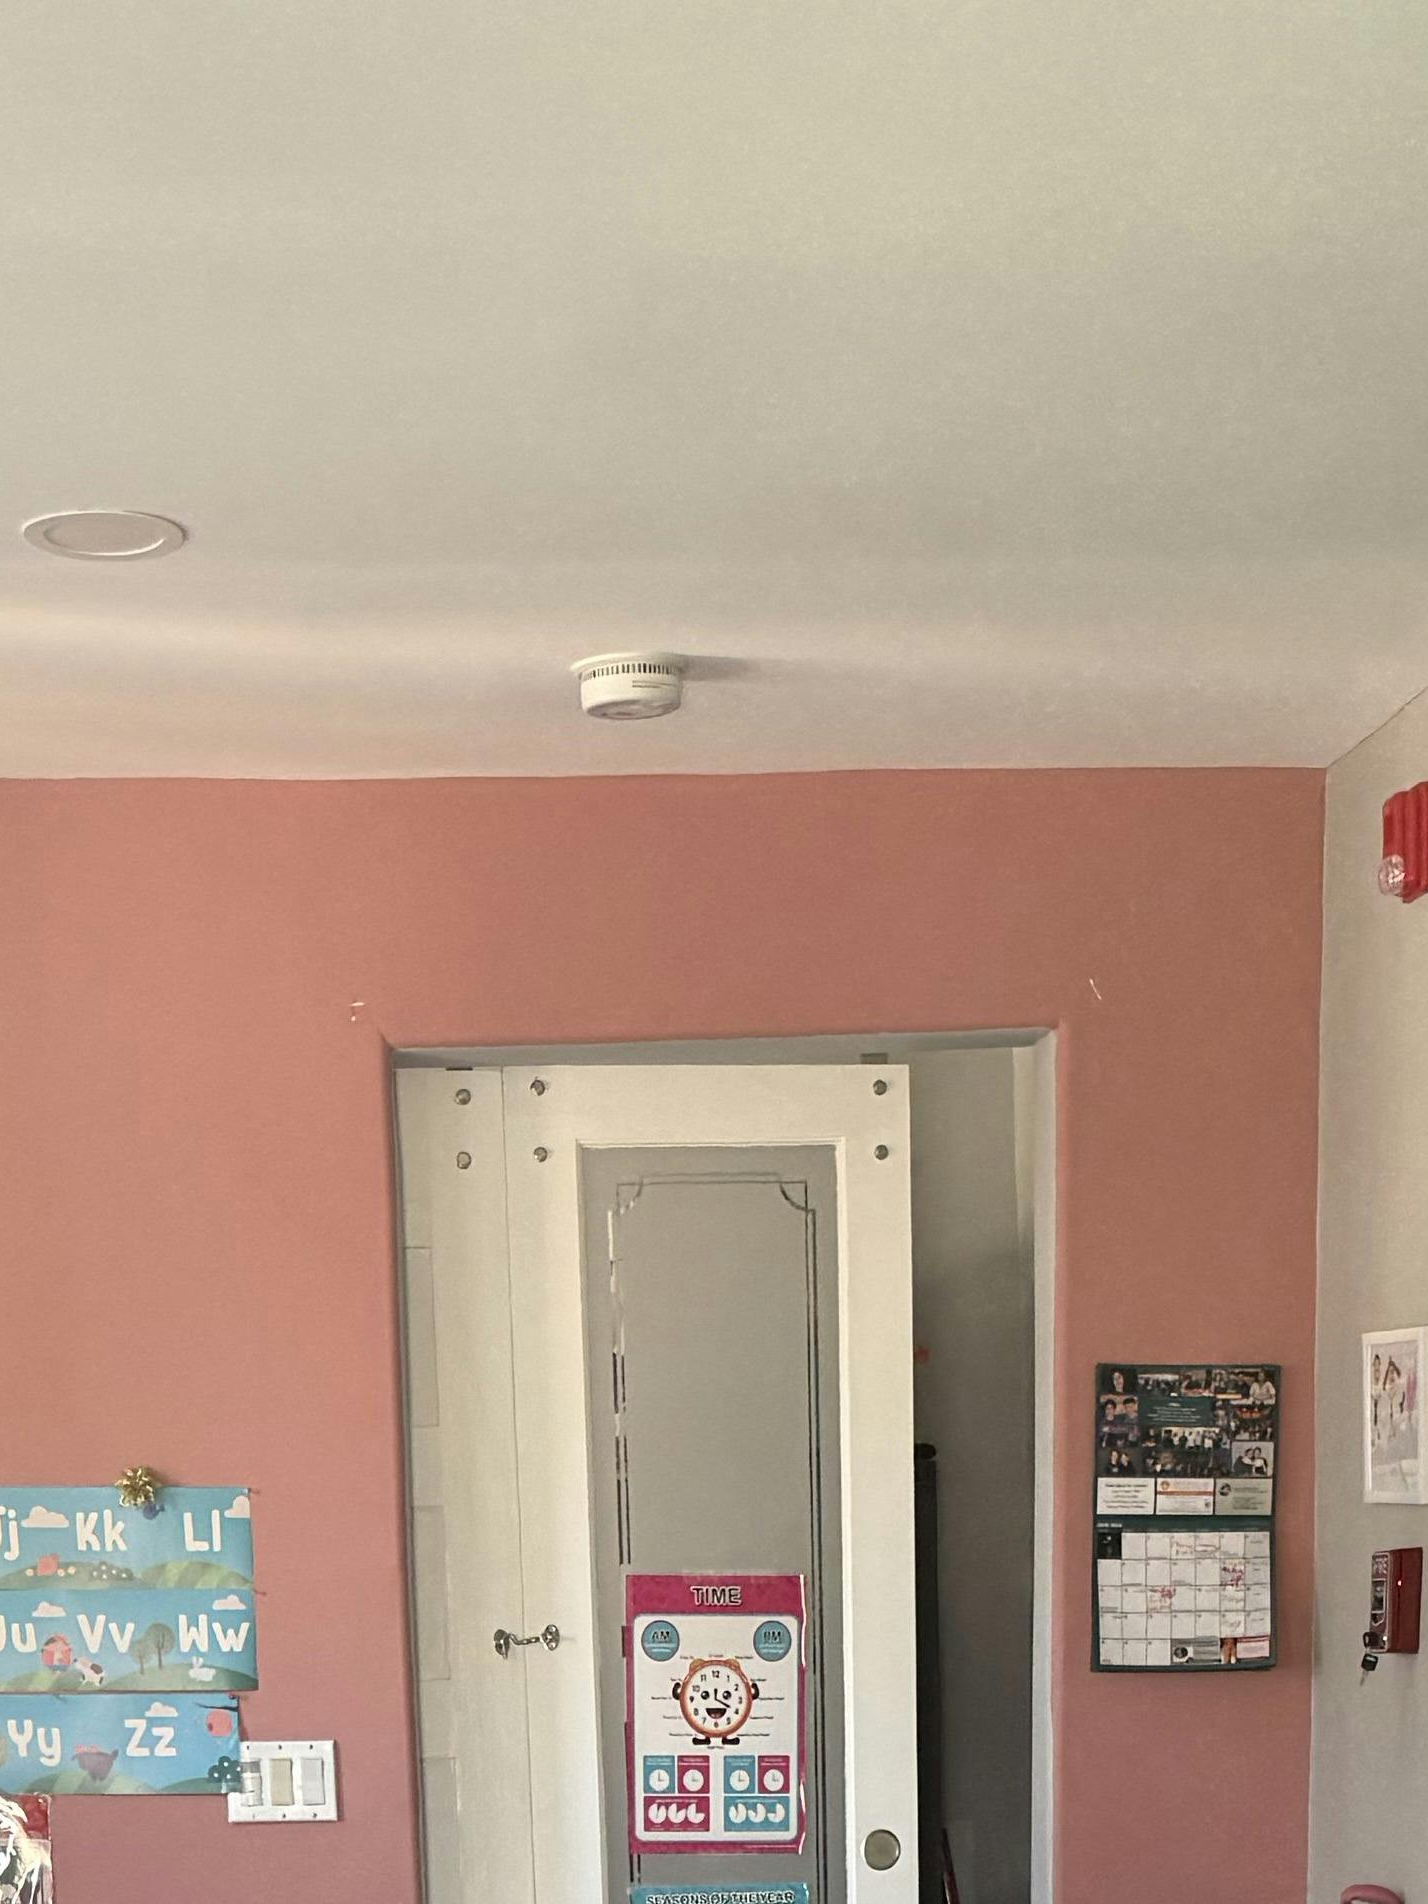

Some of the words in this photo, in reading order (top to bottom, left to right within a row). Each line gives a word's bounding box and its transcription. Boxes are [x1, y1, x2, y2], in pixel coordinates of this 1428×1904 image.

[76, 1508, 127, 1552] Kk
[183, 1509, 222, 1553] Ll
[691, 1585, 742, 1606] TIME
[77, 1614, 136, 1655] Vv
[177, 1614, 251, 1654] Ww
[6, 1718, 62, 1768] Yy
[124, 1718, 177, 1758] Zz
